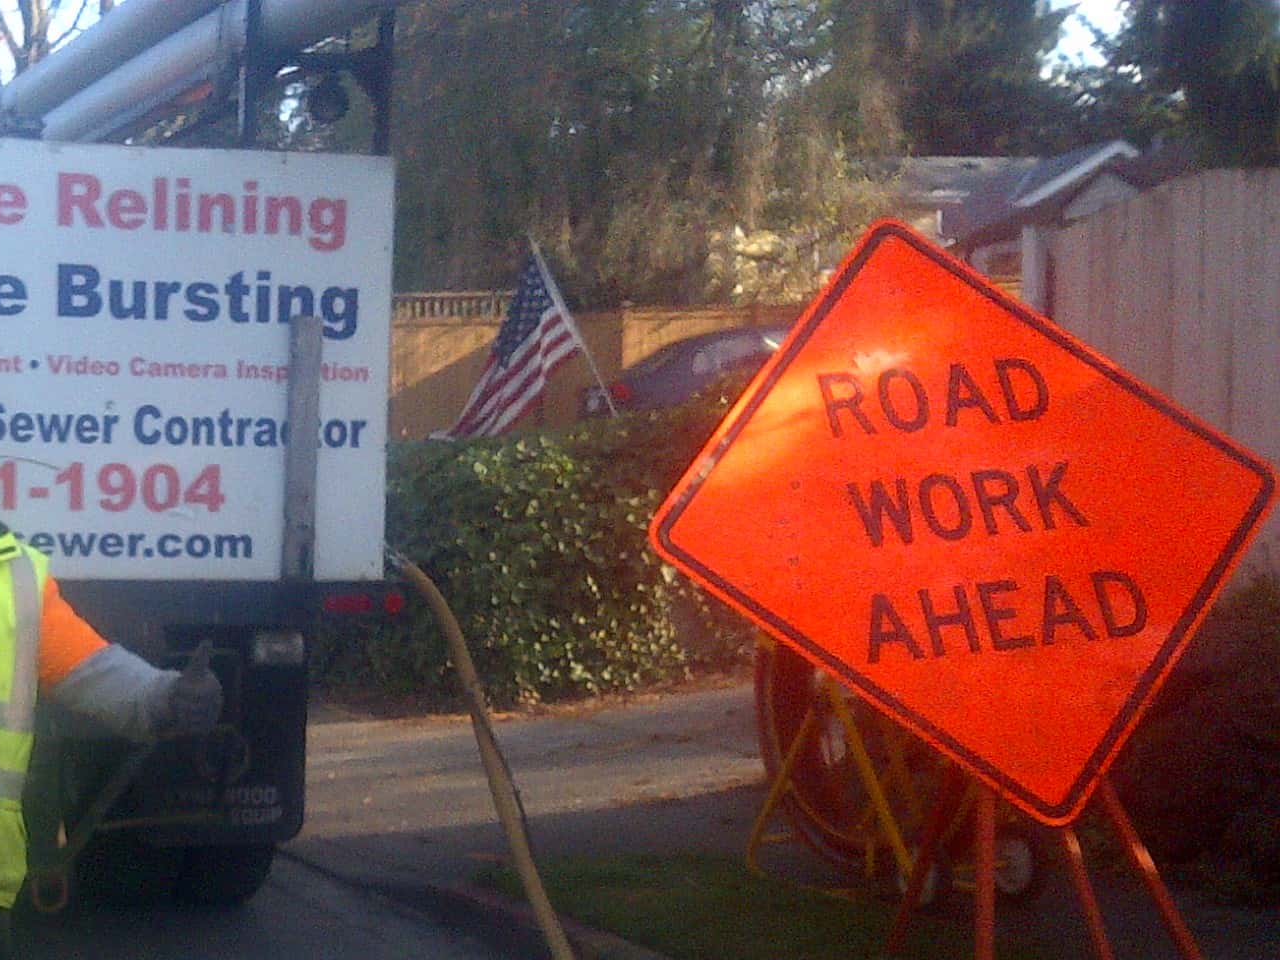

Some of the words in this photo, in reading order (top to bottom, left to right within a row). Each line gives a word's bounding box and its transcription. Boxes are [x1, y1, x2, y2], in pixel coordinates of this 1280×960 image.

[57, 172, 348, 253] Relining
[57, 263, 360, 341] Bursting
[46, 355, 120, 377] Video
[129, 356, 229, 379] Camera
[236, 360, 370, 385] Insption
[816, 357, 1051, 439] ROAD
[133, 404, 368, 449] Contraor
[846, 461, 1091, 548] WORK
[865, 570, 1150, 665] AHEAD
